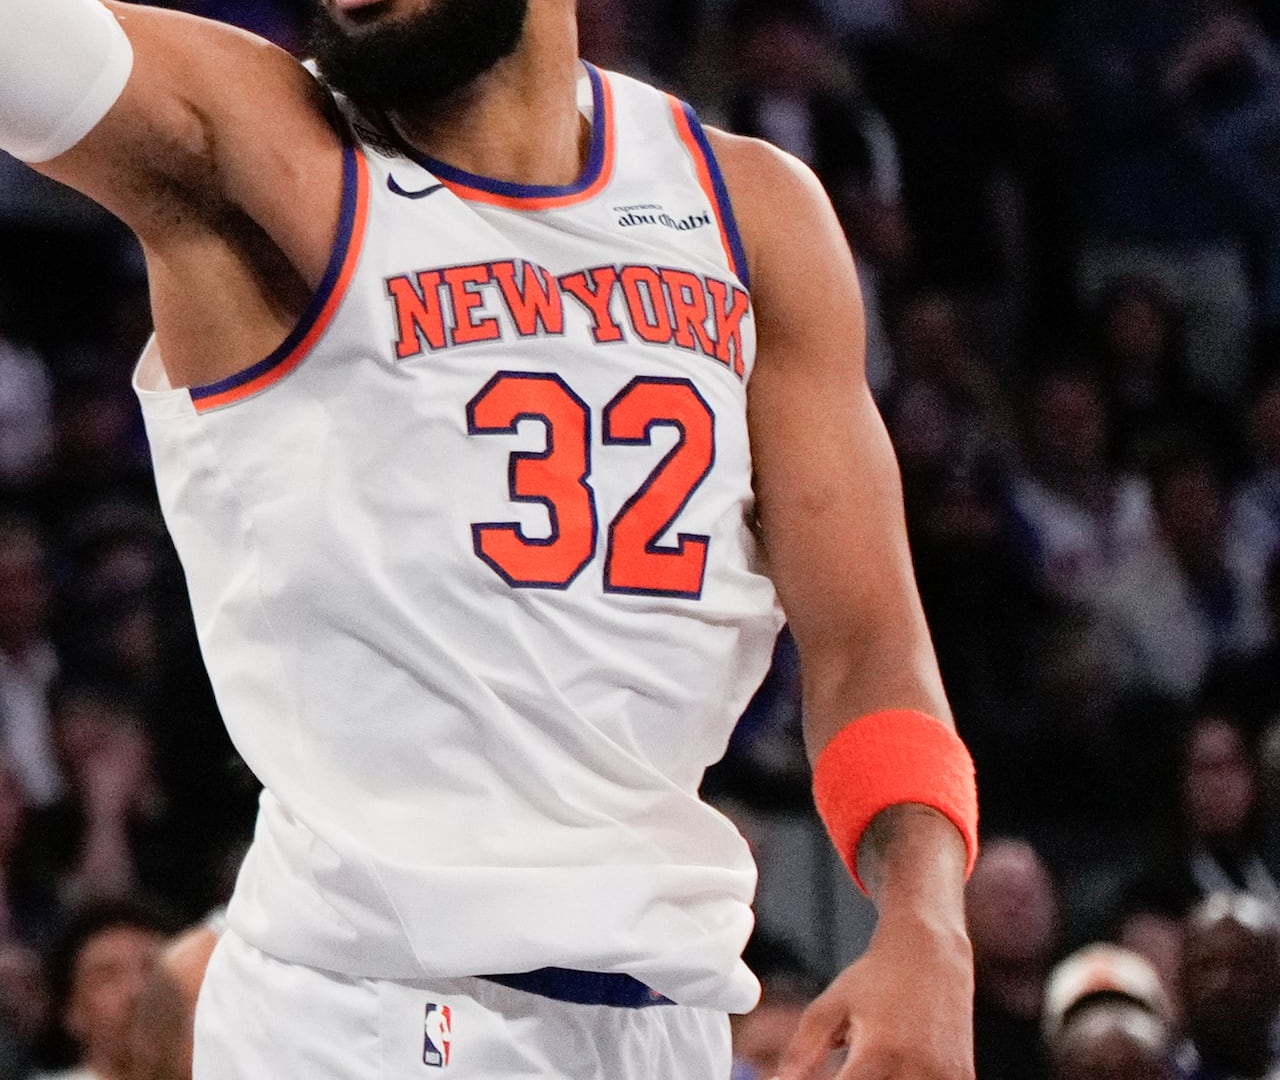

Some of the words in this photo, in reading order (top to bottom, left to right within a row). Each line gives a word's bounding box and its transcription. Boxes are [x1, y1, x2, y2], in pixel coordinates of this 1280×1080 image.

[618, 212, 657, 227] abu
[659, 210, 711, 231] dhabi
[384, 258, 567, 360] NEW
[556, 262, 750, 383] YORK
[465, 369, 716, 601] 32
